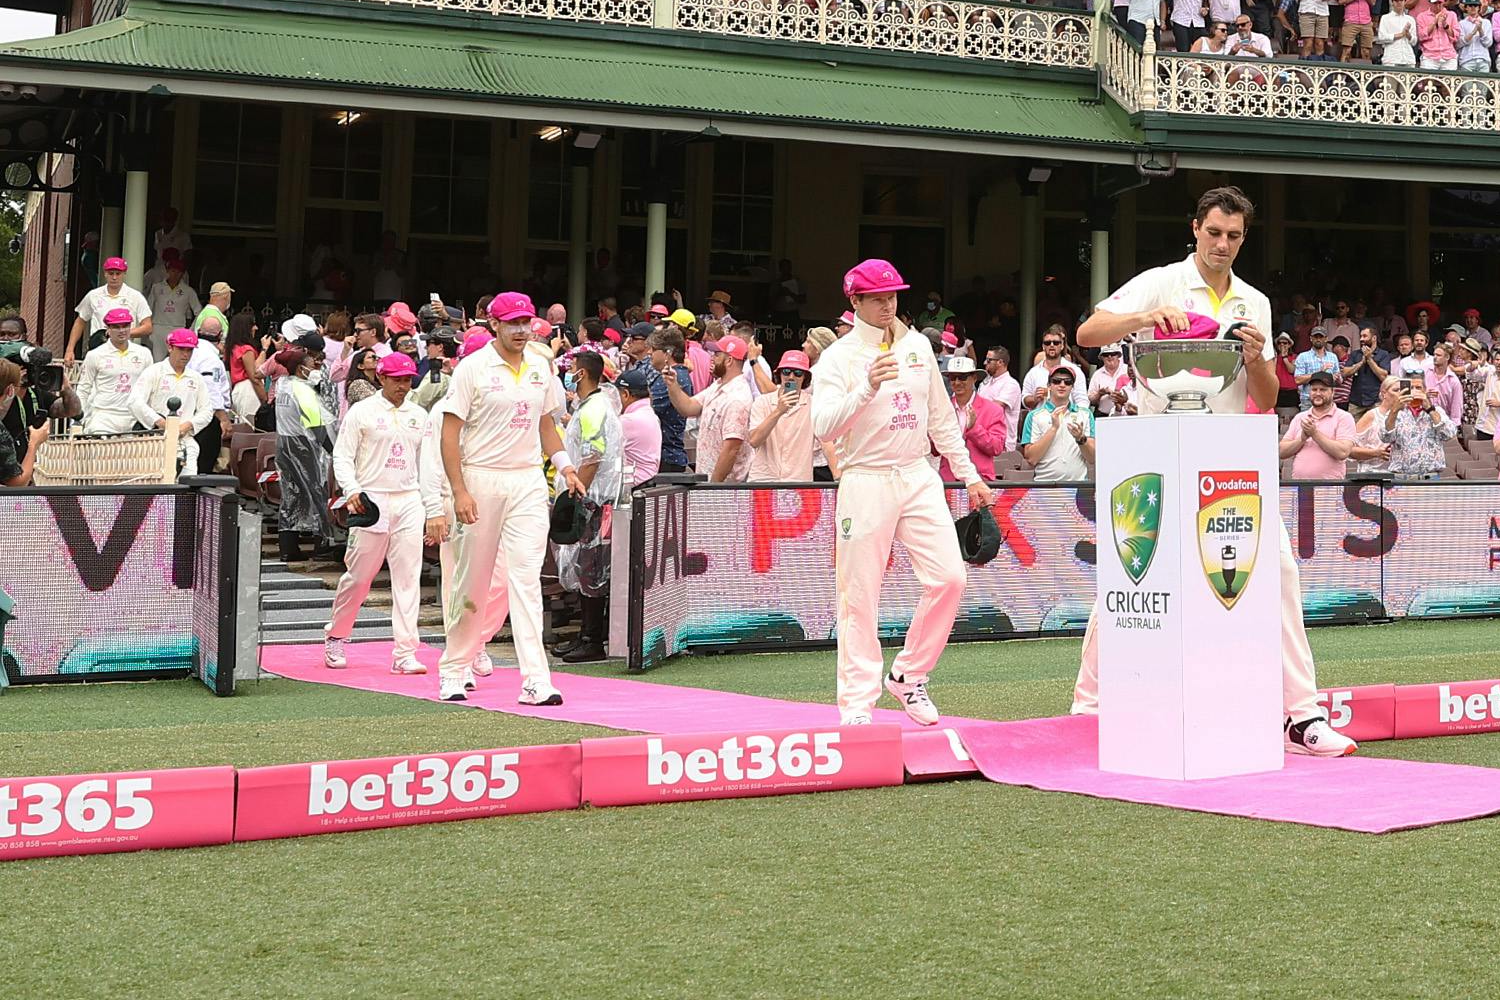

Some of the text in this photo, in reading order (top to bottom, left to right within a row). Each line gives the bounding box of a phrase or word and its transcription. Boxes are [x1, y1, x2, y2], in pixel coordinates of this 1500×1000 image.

[889, 420, 919, 430] energy
[891, 413, 917, 423] alinta
[1216, 478, 1258, 490] vodafone
[1222, 507, 1237, 516] THE
[1205, 516, 1254, 534] ASHES
[1106, 590, 1170, 614] CRICKET
[1116, 616, 1161, 630] AUSTRALIA
[647, 732, 843, 786] bet365
[308, 752, 520, 816] bet365
